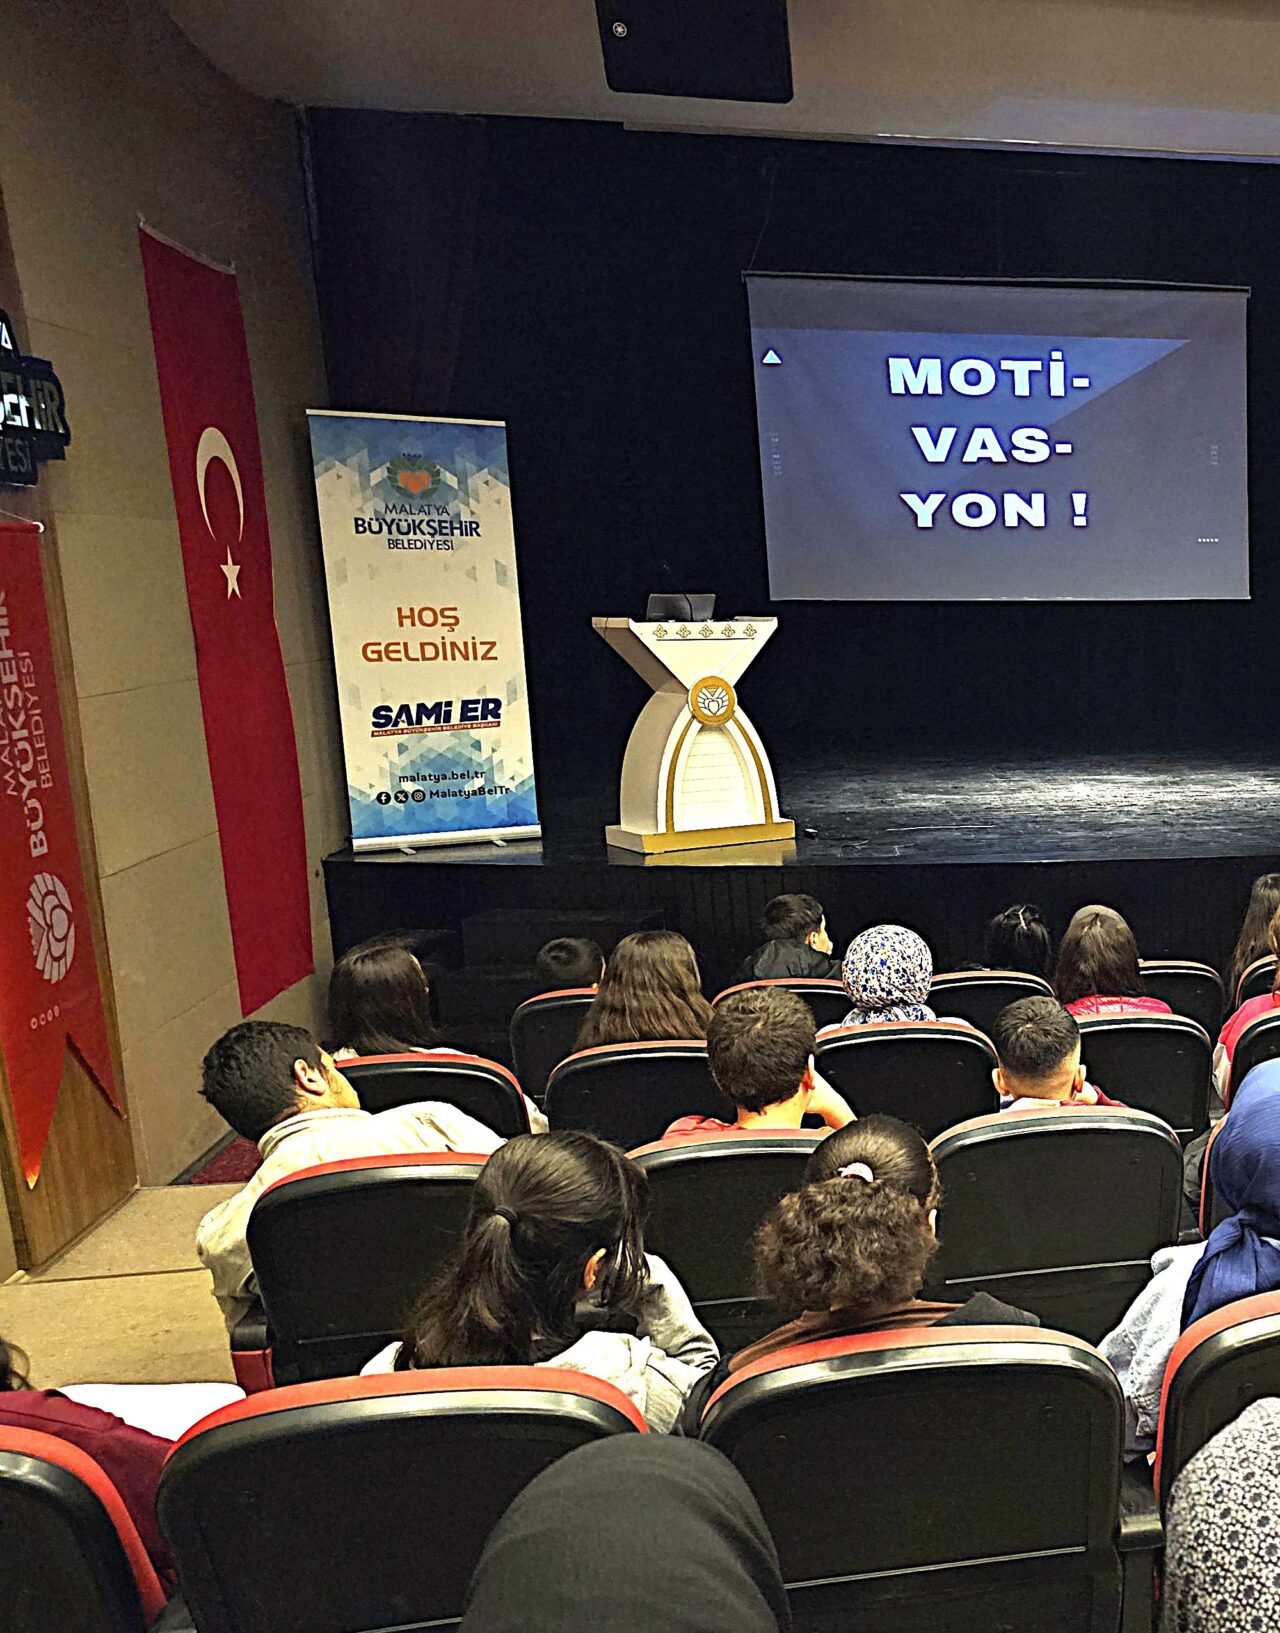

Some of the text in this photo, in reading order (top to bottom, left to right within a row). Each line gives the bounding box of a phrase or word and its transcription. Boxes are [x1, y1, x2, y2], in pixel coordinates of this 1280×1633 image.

[888, 350, 1091, 397] MOTİ-
[911, 427, 1072, 463] VAS-
[384, 503, 450, 516] MALATYA
[900, 493, 1089, 528] YON !
[353, 517, 482, 538] BÜYÜKŞEHİR
[387, 538, 454, 551] BELEDİYESİ
[396, 606, 461, 632] HOŞ
[361, 636, 499, 663] GELDİNİZ
[371, 697, 502, 729] SAMİ ER
[398, 770, 486, 784] malatya.bel.tr
[429, 785, 511, 799] MalatyaBelTr
